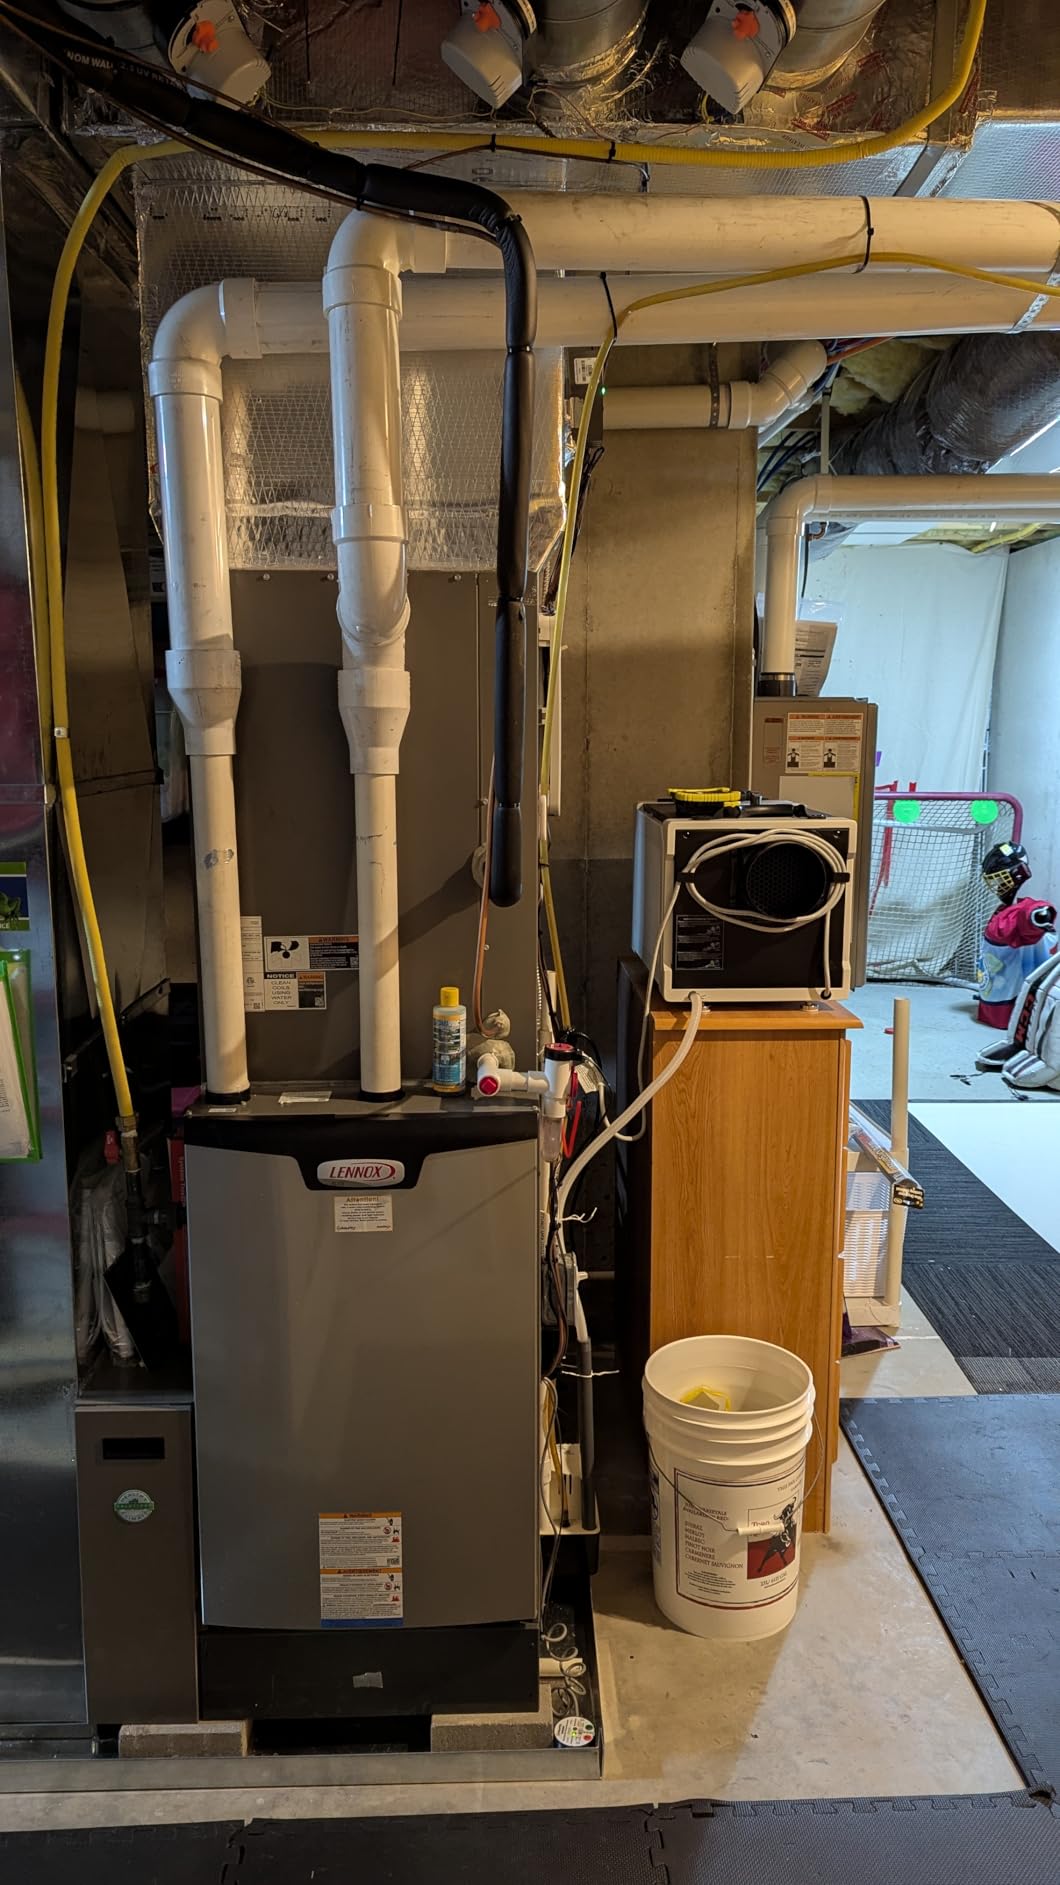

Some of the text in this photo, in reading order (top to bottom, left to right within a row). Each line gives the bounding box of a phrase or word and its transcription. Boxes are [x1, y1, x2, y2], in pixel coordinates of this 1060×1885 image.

[329, 1165, 384, 1179] LENNOX
[684, 1540, 701, 1550] PINOT
[684, 1554, 744, 1569] CABERNET SAUVIGNON
